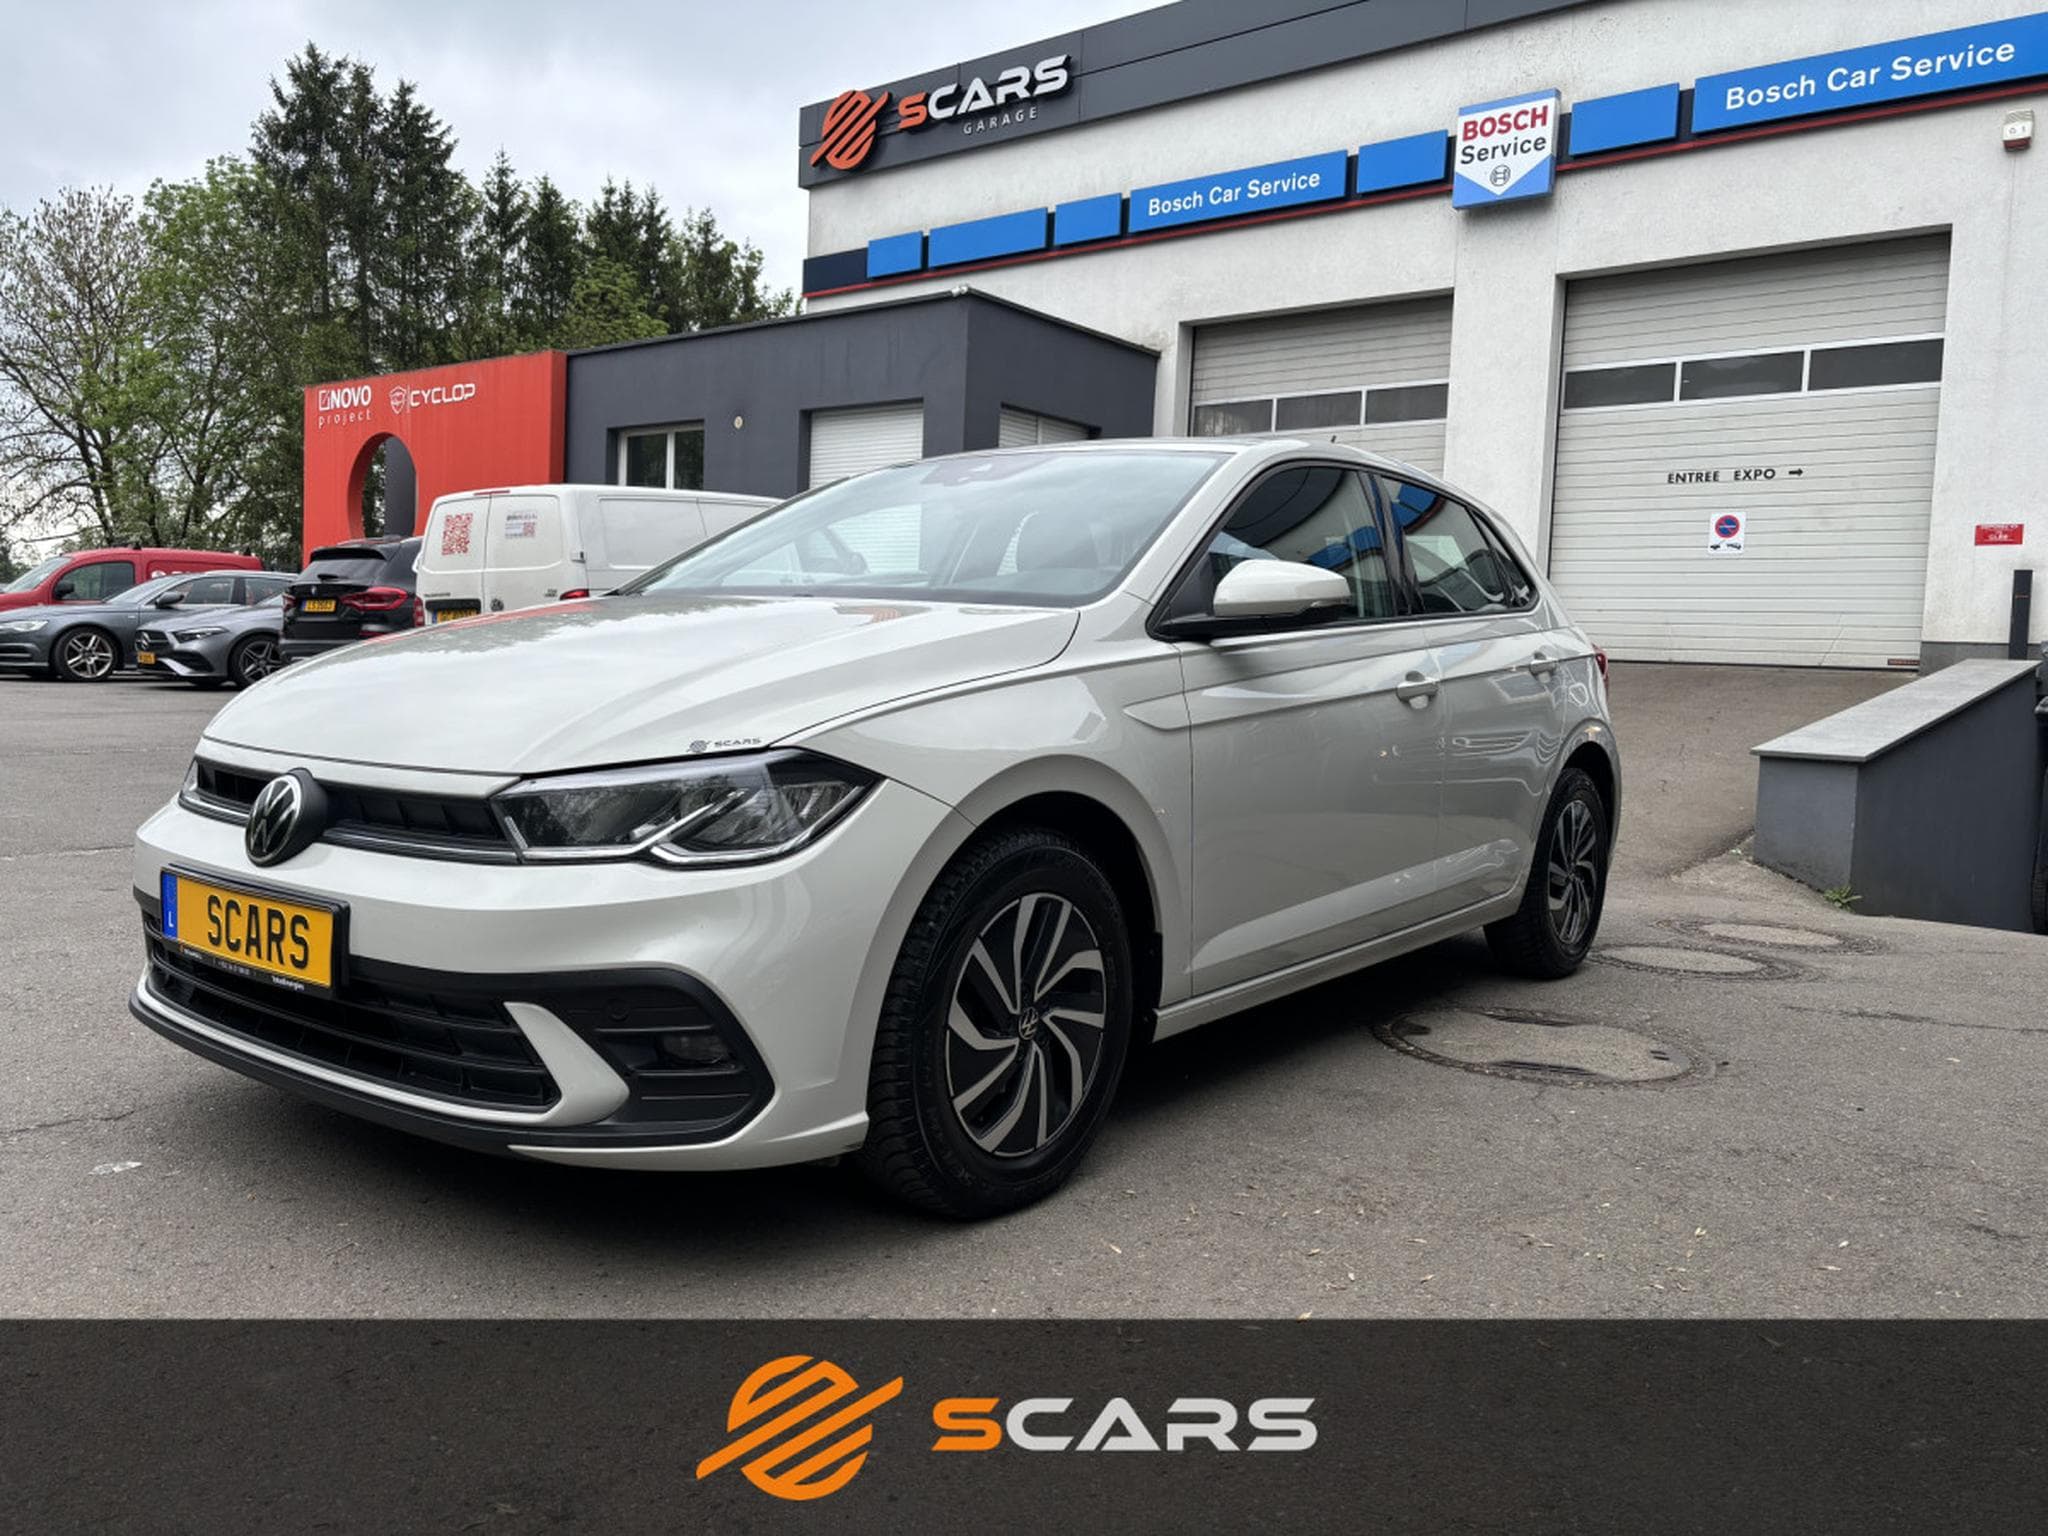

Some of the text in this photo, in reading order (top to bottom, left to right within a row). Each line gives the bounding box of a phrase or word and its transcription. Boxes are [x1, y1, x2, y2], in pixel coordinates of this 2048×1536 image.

[1725, 42, 2016, 111] Bosch Car Service
[897, 54, 1070, 131] SCARS
[963, 107, 1038, 135] GARAGE
[1462, 105, 1549, 142] BOSCH
[1460, 136, 1547, 165] Service
[1148, 172, 1321, 217] Bosch Car Service
[409, 383, 476, 407] CYCLOP
[318, 409, 372, 429] project
[1667, 468, 1776, 484] ENTREE EXPO
[714, 737, 762, 748] SCARS
[167, 910, 175, 928] L
[207, 894, 310, 970] SCARS
